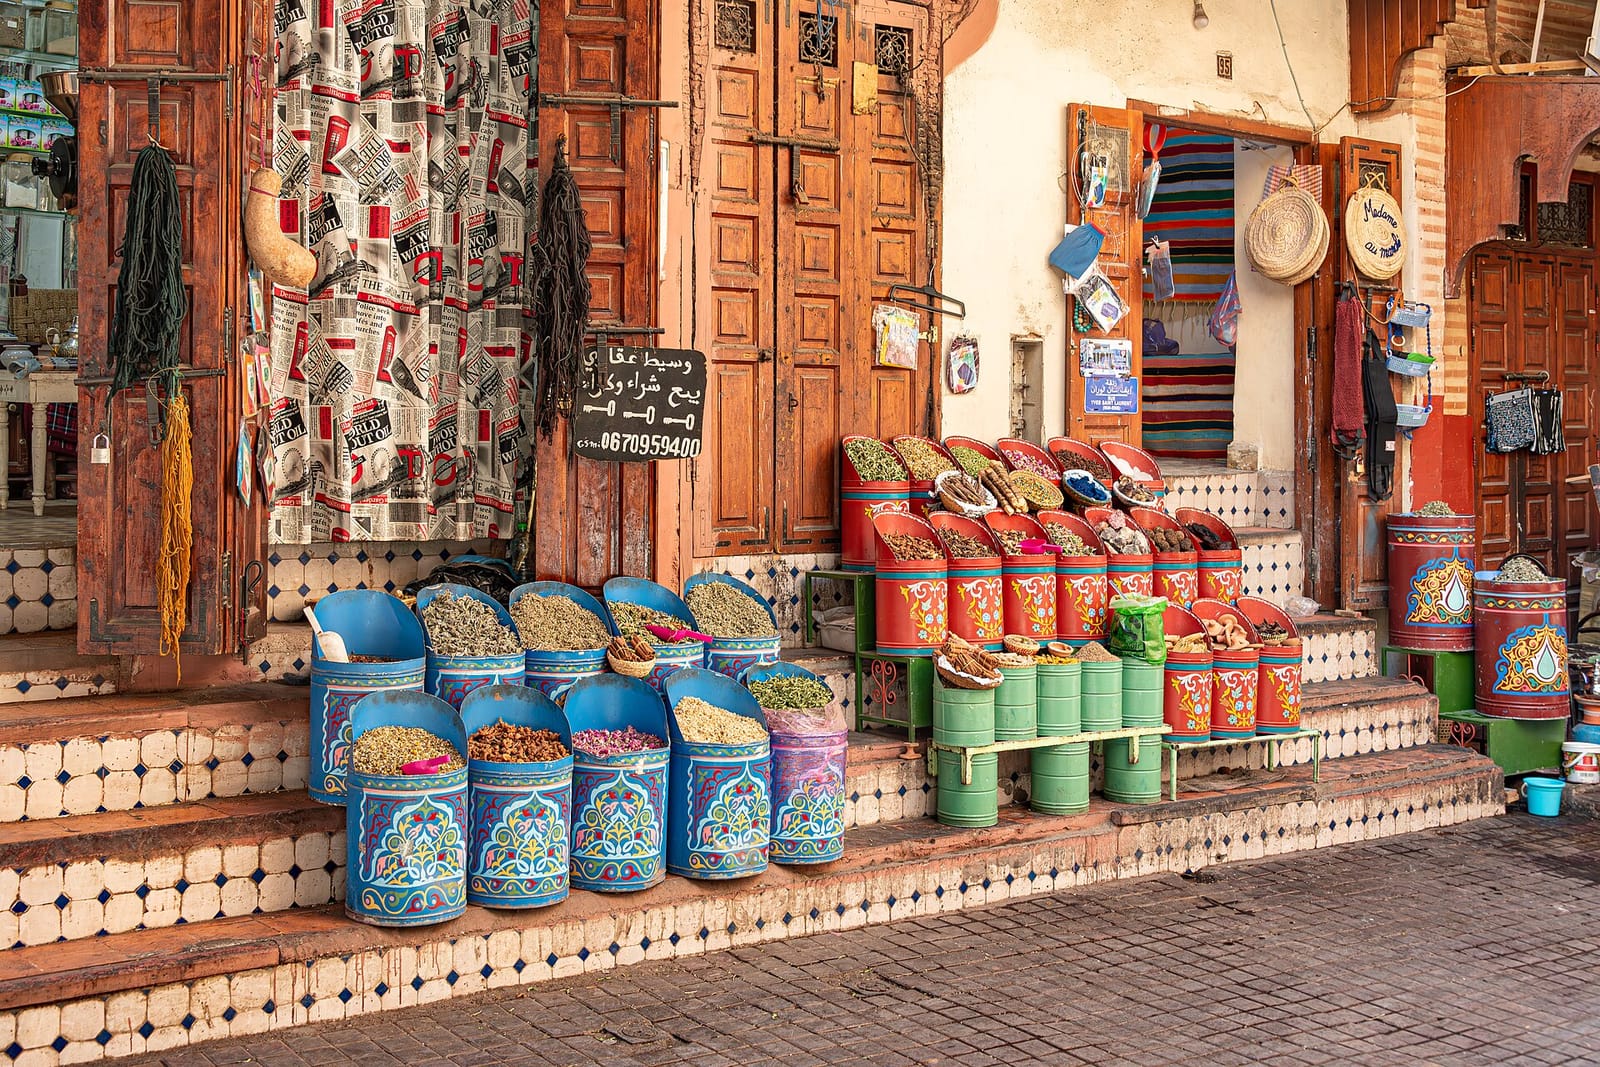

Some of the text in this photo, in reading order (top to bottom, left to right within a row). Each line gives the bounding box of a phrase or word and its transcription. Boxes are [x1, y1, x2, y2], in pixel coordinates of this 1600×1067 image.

[1364, 198, 1398, 229] Madame
[400, 242, 430, 262] WITH
[363, 279, 384, 292] THE
[583, 347, 692, 375] وسيط عقاي
[627, 370, 661, 400] شراء
[286, 425, 307, 442] OIL
[600, 430, 701, 458] 0670959400
